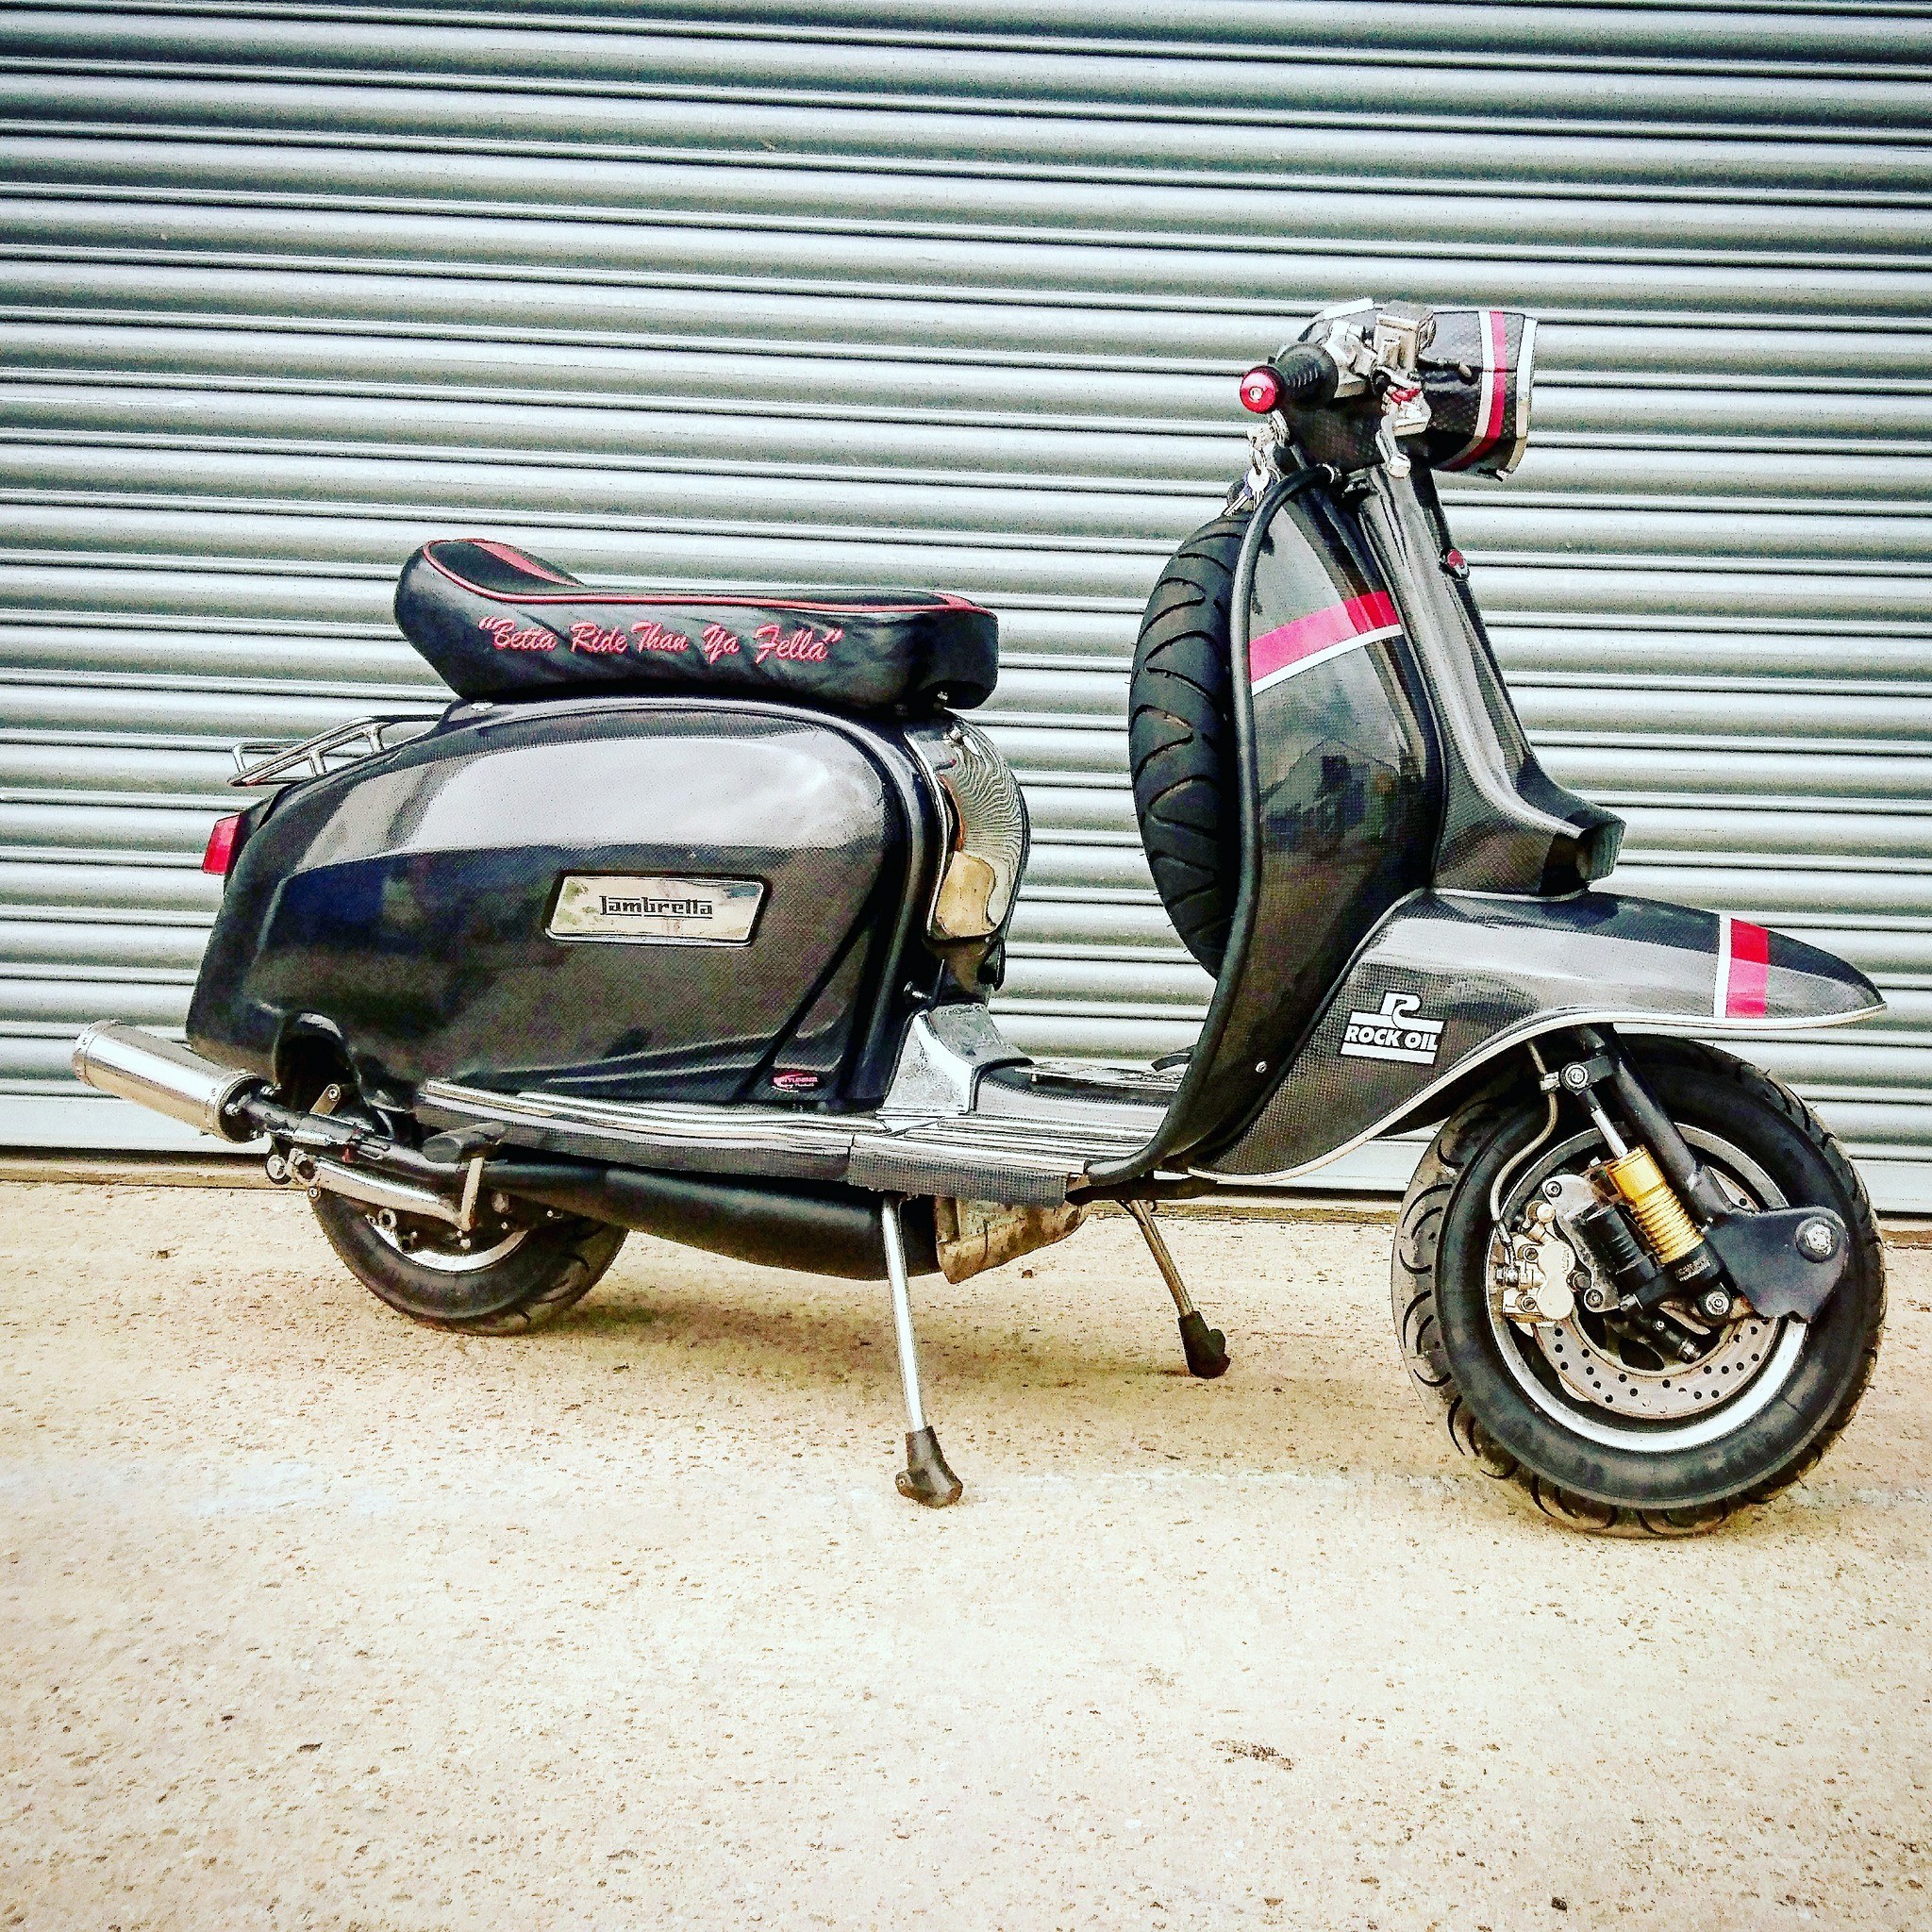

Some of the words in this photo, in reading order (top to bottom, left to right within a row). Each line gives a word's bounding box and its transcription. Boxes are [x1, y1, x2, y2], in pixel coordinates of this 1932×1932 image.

[570, 621, 628, 654] Ride
[631, 620, 689, 653] Than
[703, 624, 740, 664] Ya
[1343, 1024, 1403, 1047] ROCK
[1404, 1032, 1438, 1051] OIL
